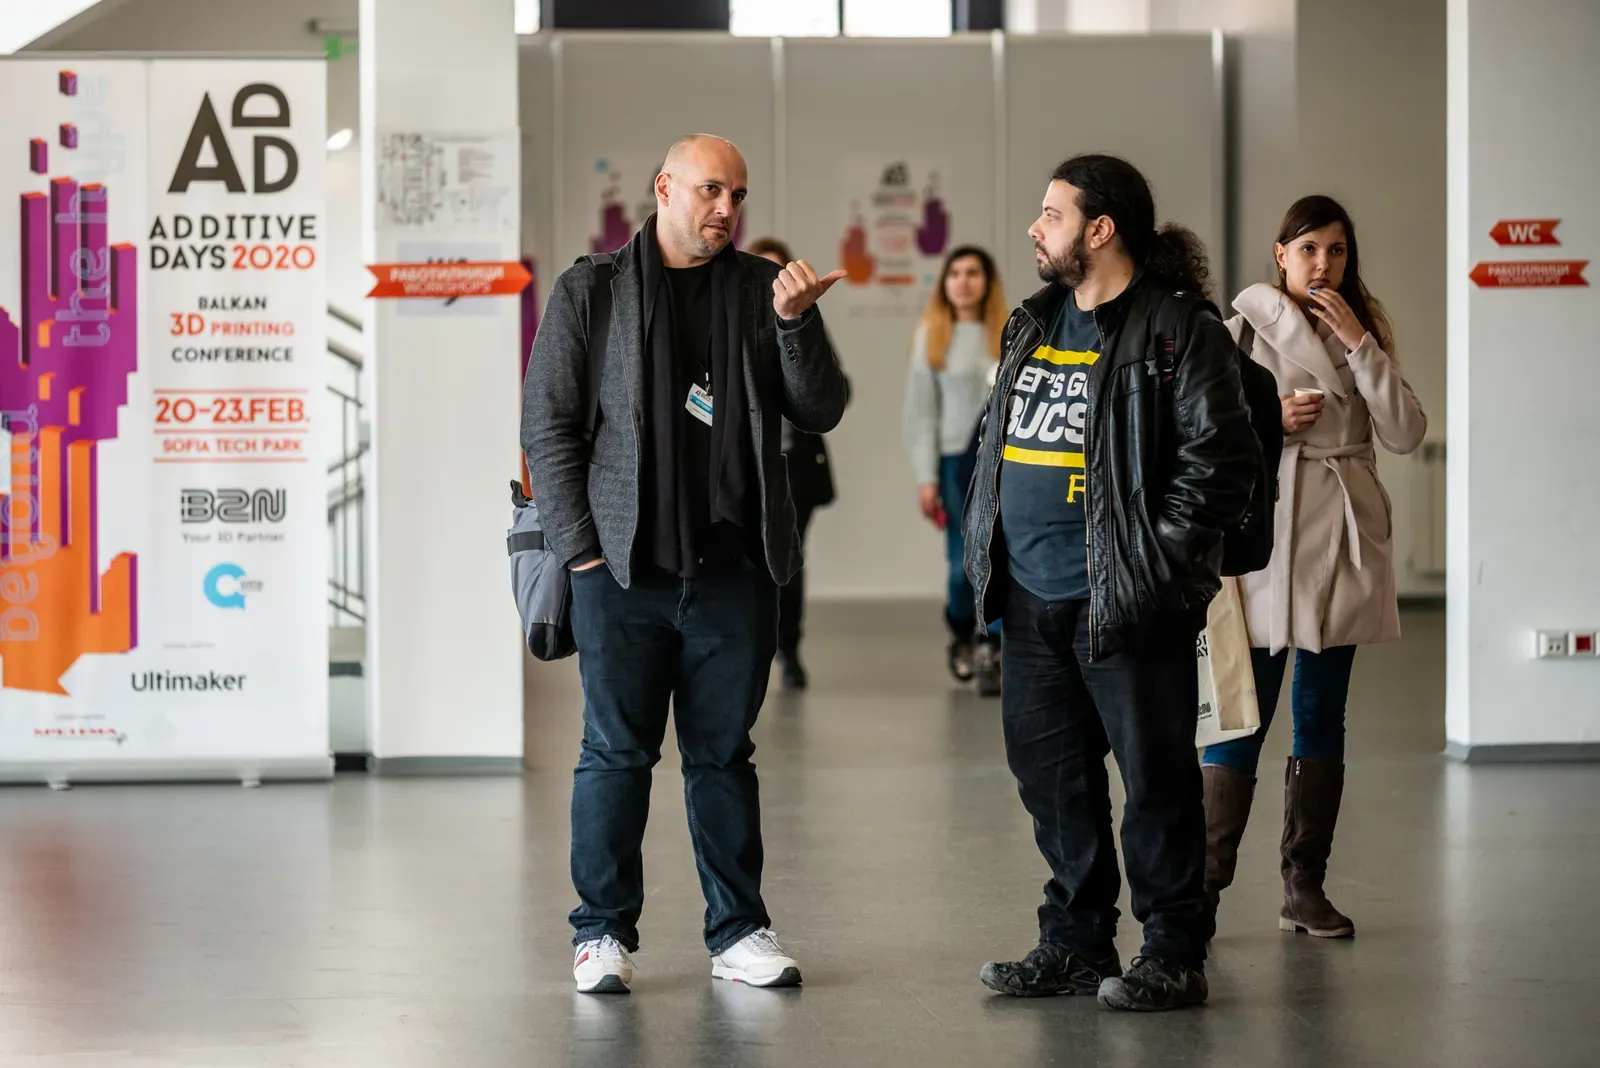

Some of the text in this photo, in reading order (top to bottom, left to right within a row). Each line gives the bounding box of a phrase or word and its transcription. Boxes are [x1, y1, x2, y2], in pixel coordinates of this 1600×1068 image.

[148, 214, 317, 240] ADDITIVE
[1507, 223, 1541, 243] WC
[150, 245, 316, 270] DAYS 2020
[55, 247, 110, 347] the
[198, 296, 267, 310] BALKAN
[170, 313, 295, 336] 3D PRINTING
[171, 347, 293, 362] CONFERENCE
[1014, 366, 1065, 398] ET'S
[162, 438, 302, 453] SOFIA TECH PARK
[181, 488, 286, 523] B2N
[130, 669, 247, 692] Ultimaker
